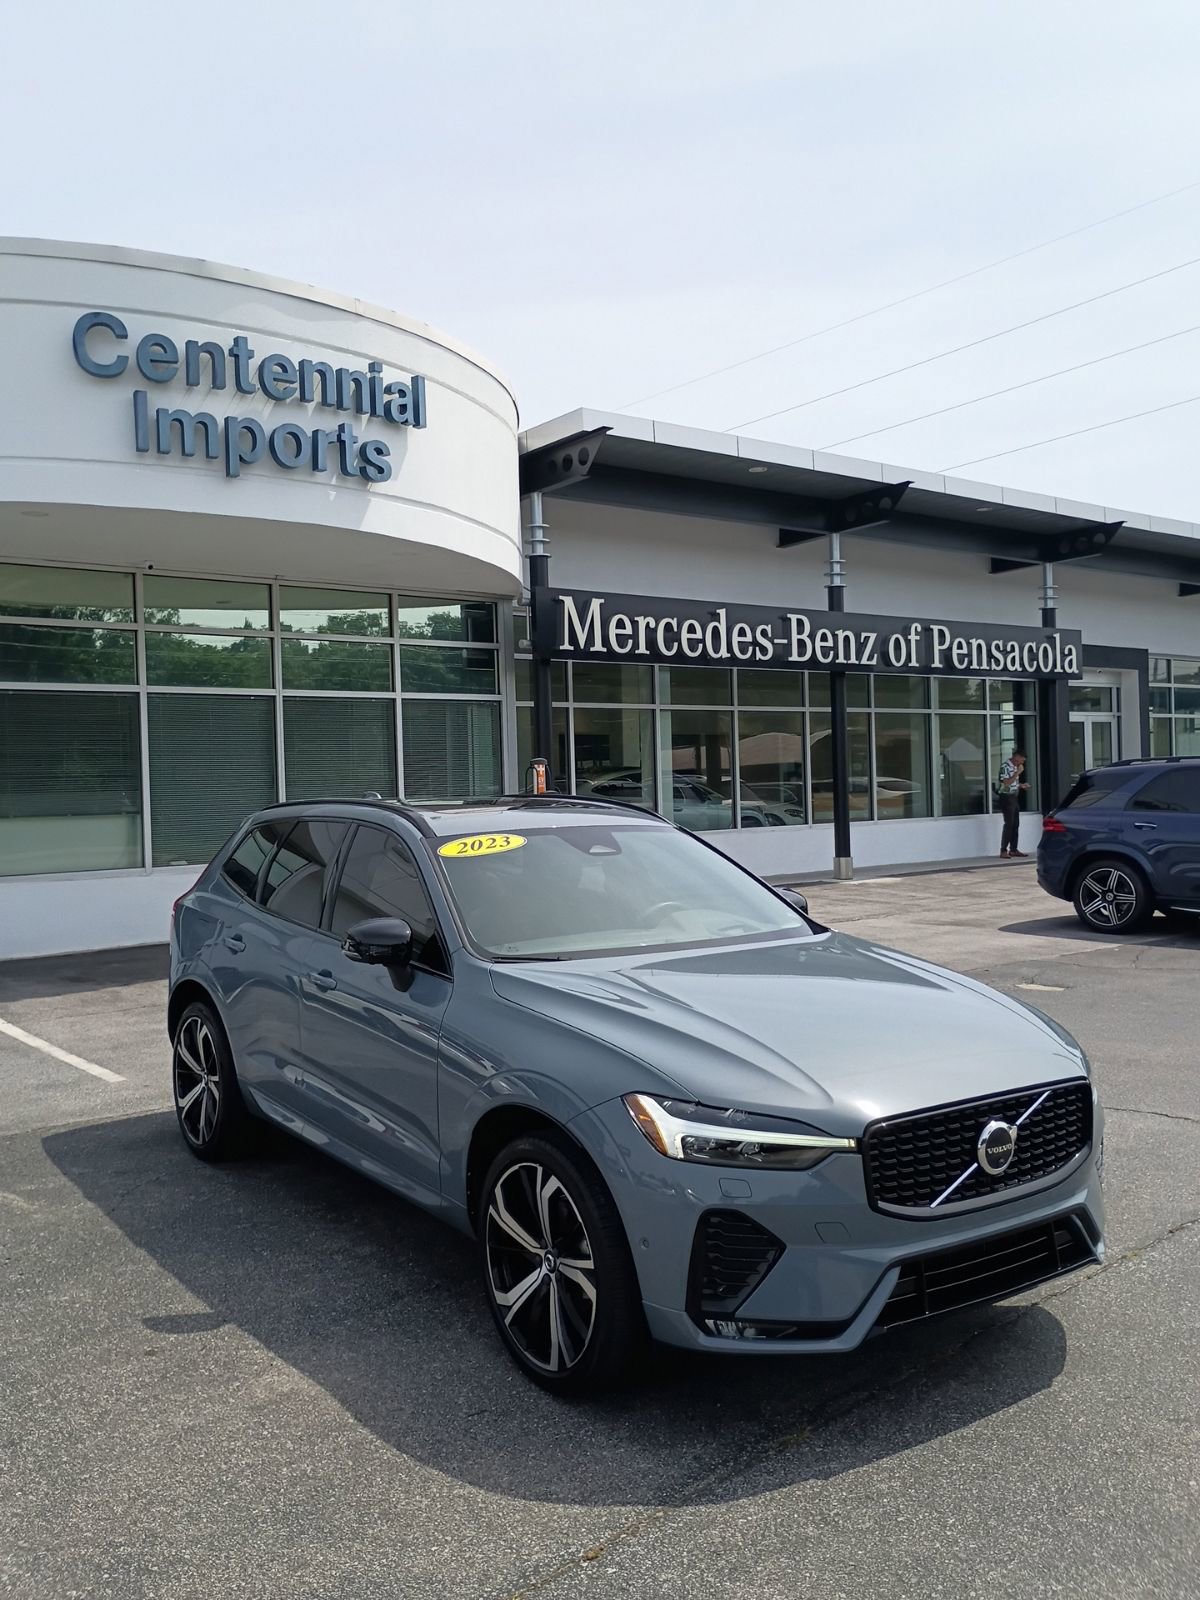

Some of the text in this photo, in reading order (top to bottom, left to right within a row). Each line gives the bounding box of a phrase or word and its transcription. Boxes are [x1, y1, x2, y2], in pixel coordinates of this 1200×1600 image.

[72, 311, 427, 429] Centennial
[133, 390, 392, 483] Imports
[558, 595, 1079, 674] Mercedes-Benz of Pensacola
[456, 836, 511, 854] 2023
[987, 1143, 1012, 1154] VOLVO
